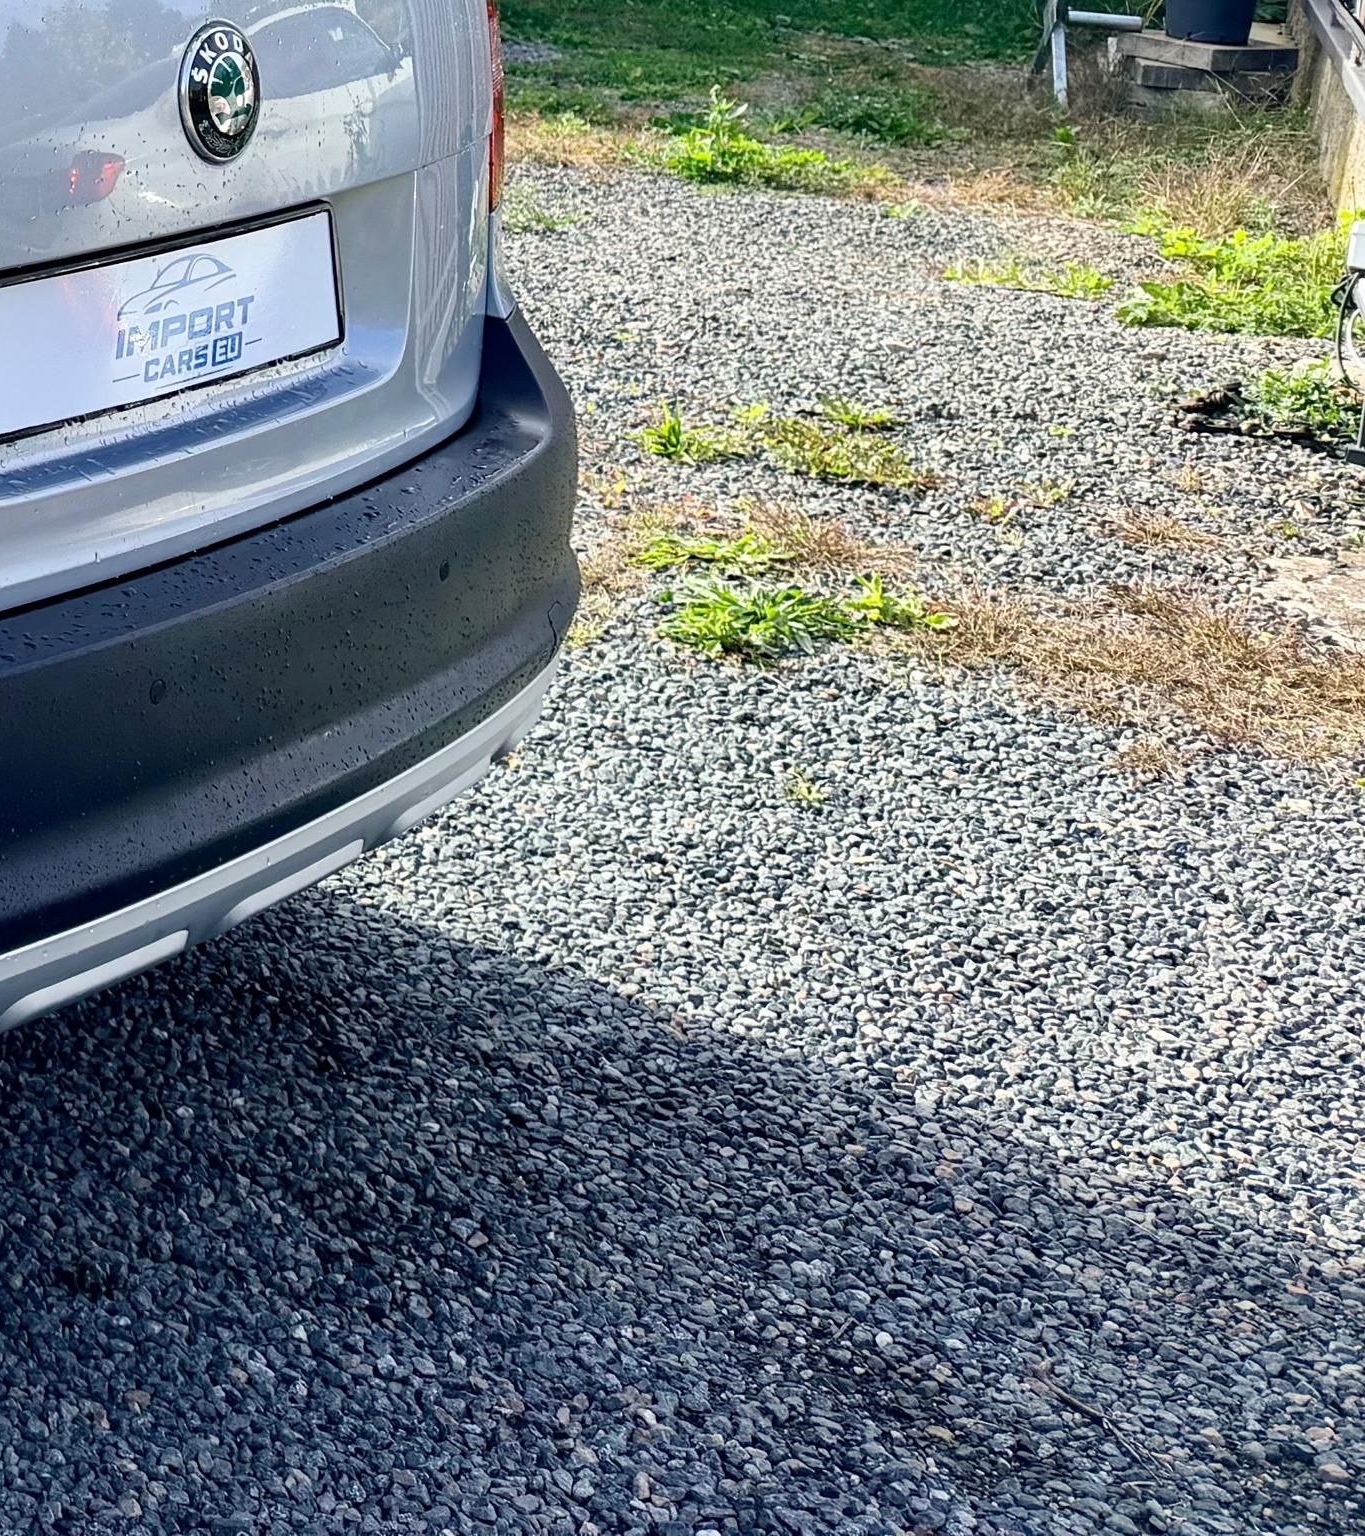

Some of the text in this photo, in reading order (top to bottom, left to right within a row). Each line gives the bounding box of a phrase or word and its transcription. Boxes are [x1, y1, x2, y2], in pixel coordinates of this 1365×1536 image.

[191, 31, 253, 84] ŠKODA
[116, 295, 254, 359] IMPORT
[143, 343, 208, 383] CARS
